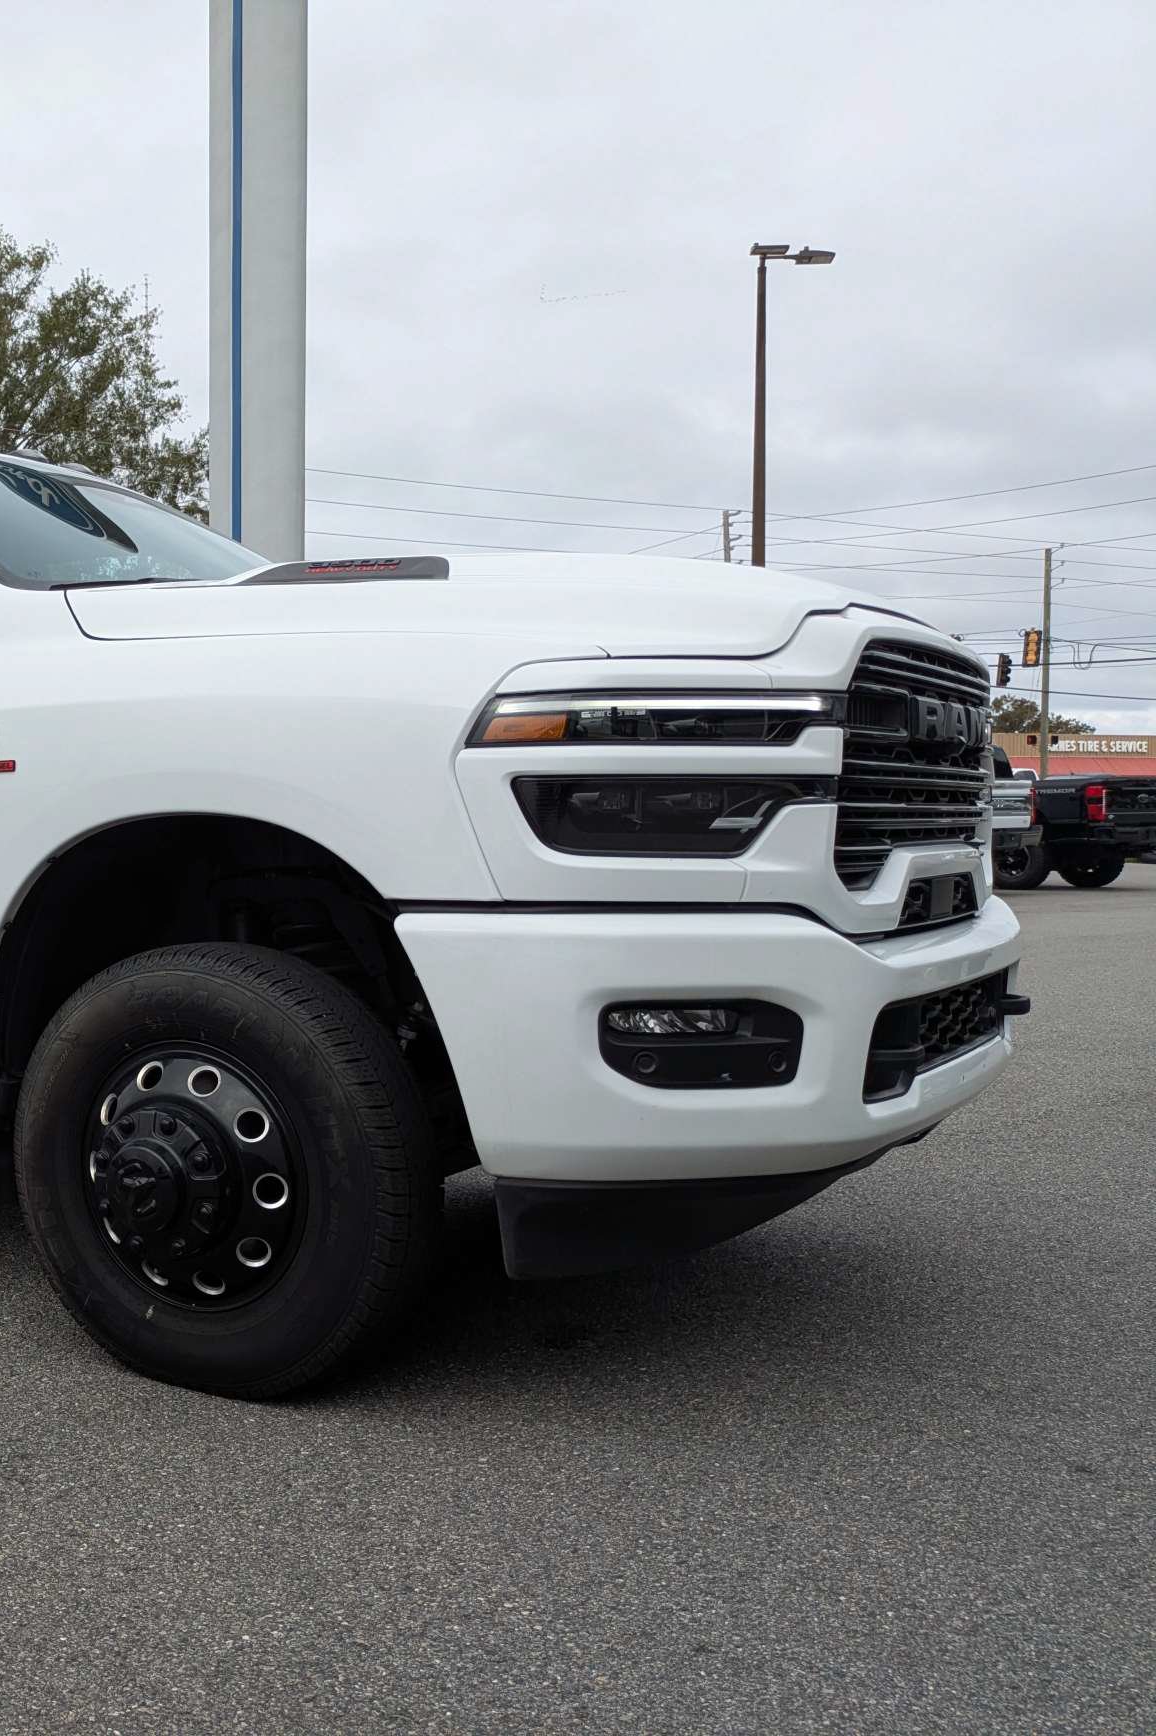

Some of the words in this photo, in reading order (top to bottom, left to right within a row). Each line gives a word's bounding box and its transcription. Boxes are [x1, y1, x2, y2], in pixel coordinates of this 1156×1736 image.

[915, 697, 987, 747] RAM
[1077, 740, 1100, 752] TIRE
[1101, 740, 1109, 752] &
[1109, 740, 1149, 753] SERVICE
